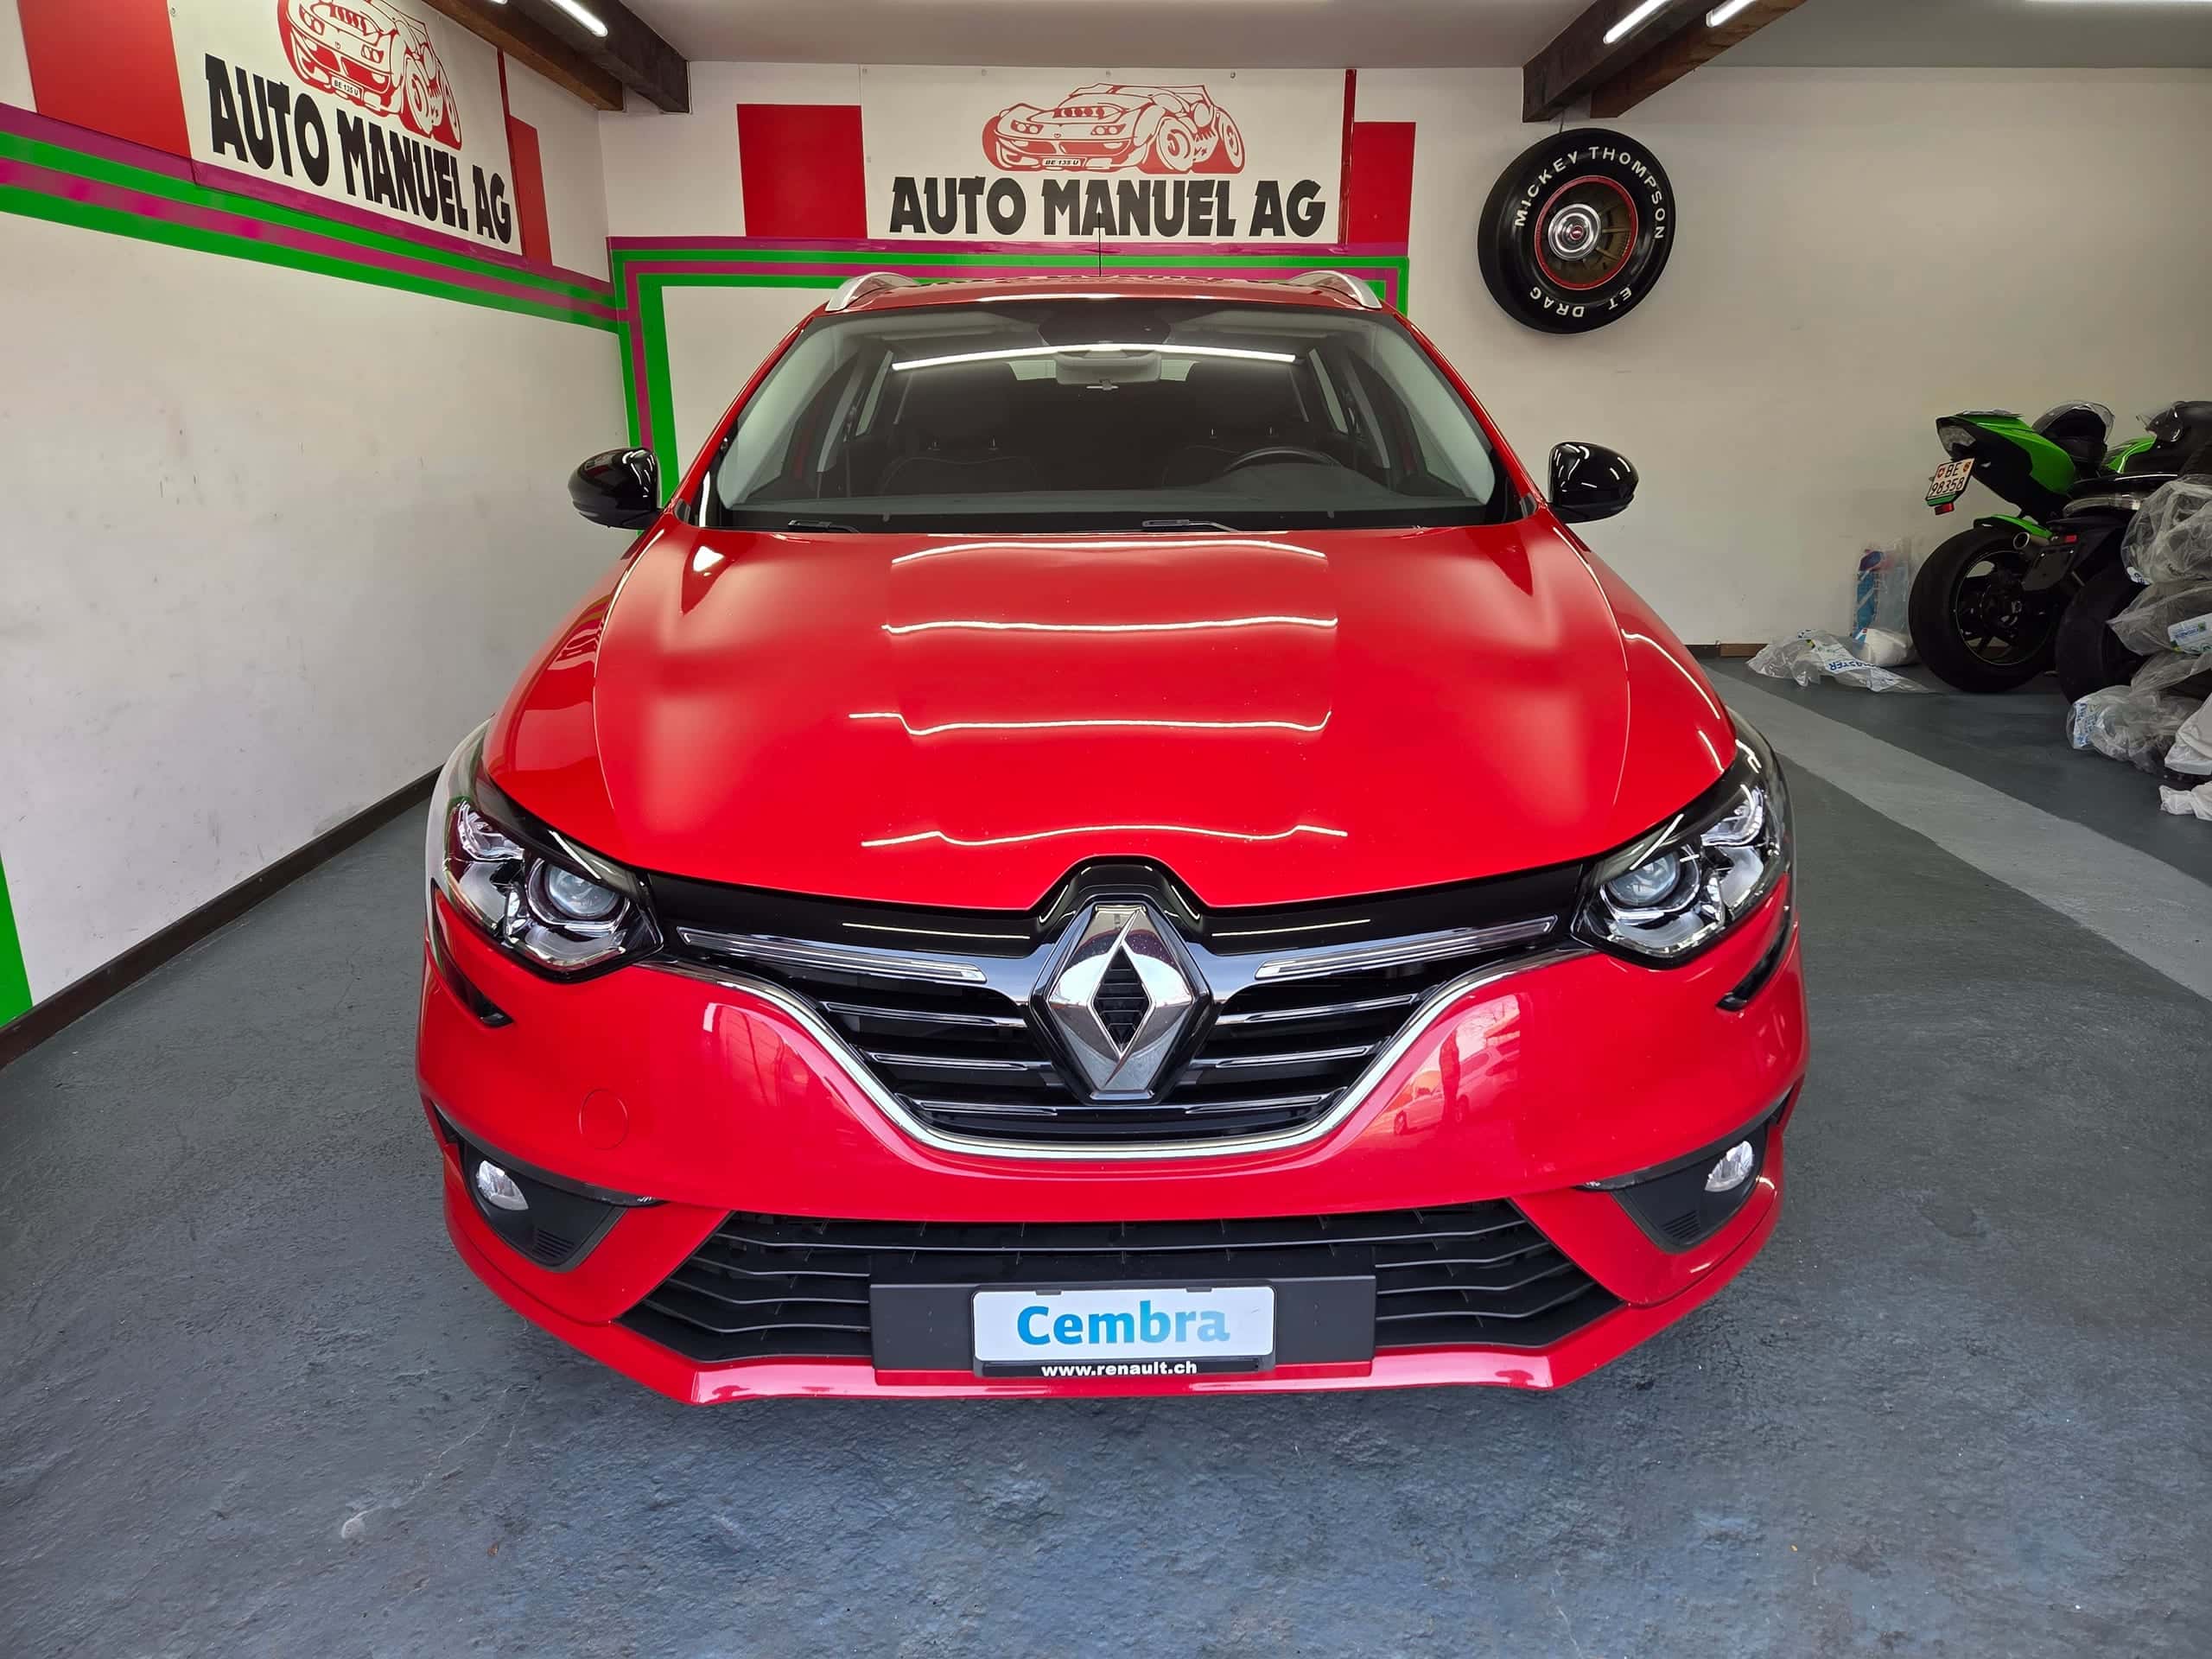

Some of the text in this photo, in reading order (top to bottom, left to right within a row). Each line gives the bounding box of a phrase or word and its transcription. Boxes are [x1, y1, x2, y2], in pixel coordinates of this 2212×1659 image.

[206, 54, 512, 245] AUTO MANUEL AG
[890, 176, 1326, 238] AUTO MANUEL AG
[1515, 146, 1666, 239] MICKEY THOMPSON
[1529, 286, 1632, 318] ET DRAG
[1929, 476, 1965, 496] 98358
[1944, 461, 1963, 478] BE
[1017, 1300, 1231, 1345] Cembra
[1041, 1360, 1198, 1377] www.renault.ch
